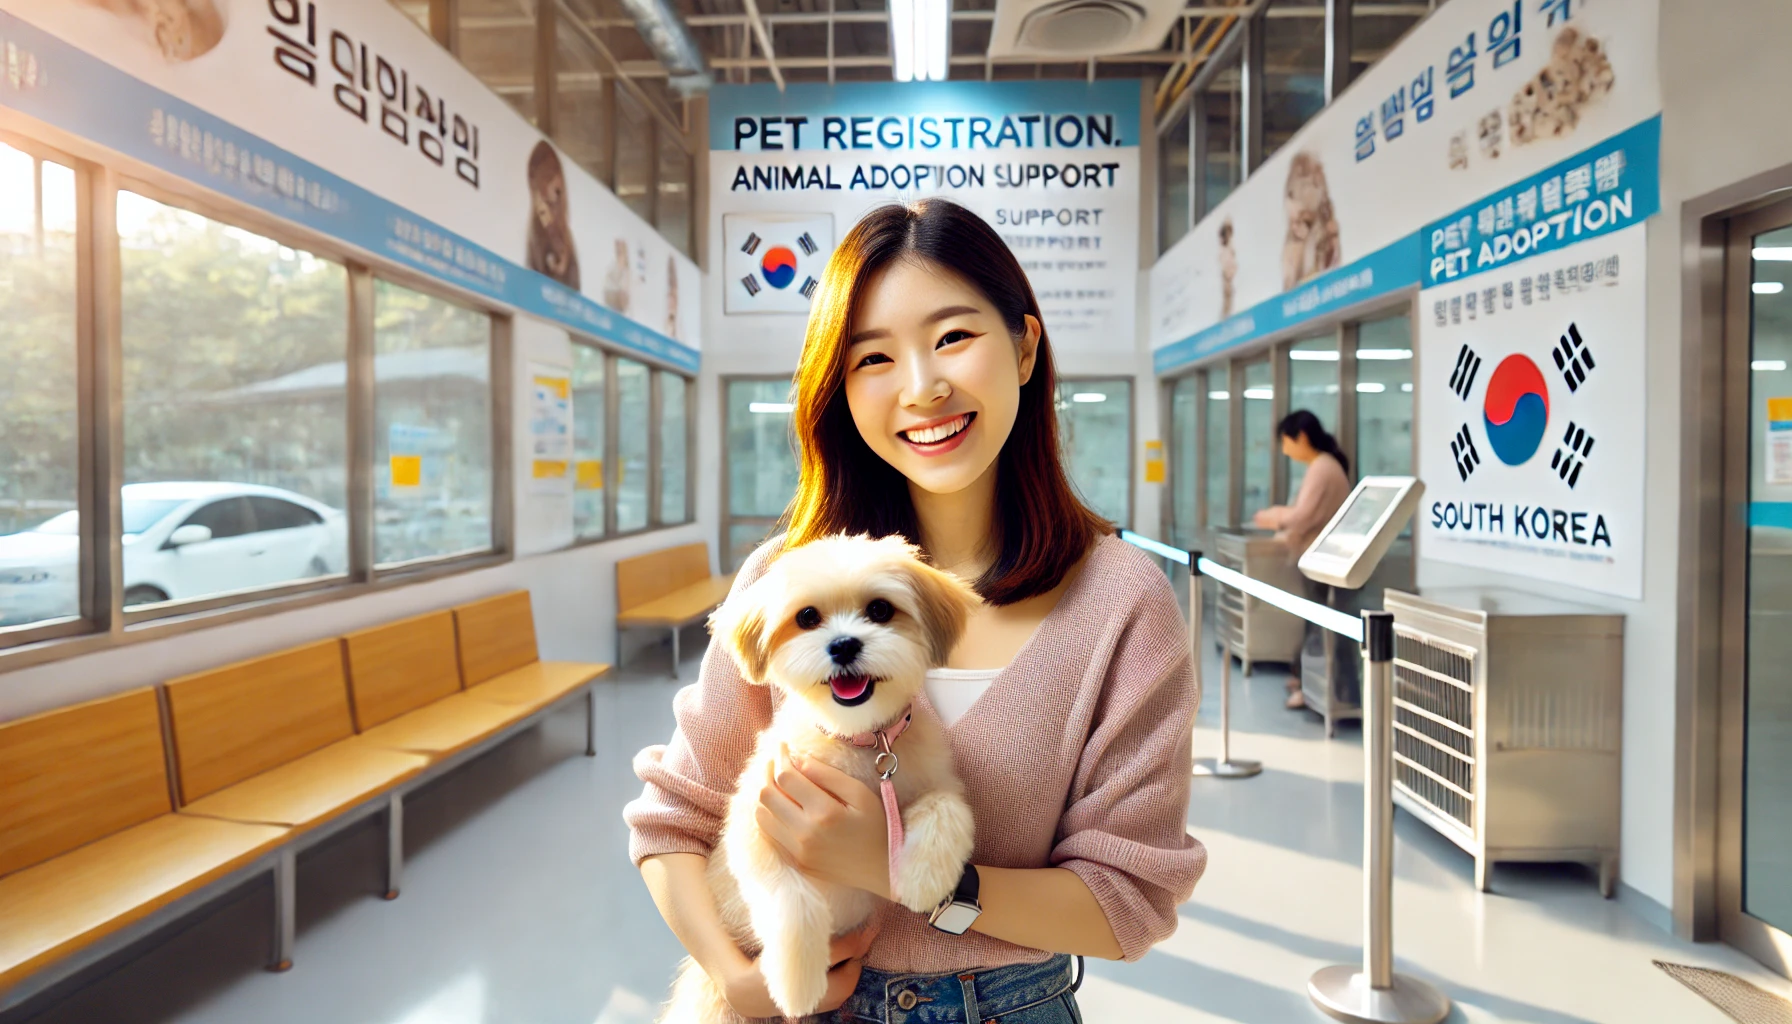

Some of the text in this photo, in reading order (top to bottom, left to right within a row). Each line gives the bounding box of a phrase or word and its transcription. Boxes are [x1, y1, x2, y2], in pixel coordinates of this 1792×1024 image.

[734, 113, 1122, 151] PET REGISTRATION.
[731, 162, 1120, 192] ANIMAL ADOPTION SUPPORT
[996, 208, 1104, 226] SUPPORT
[1430, 247, 1473, 282] PET
[1477, 187, 1633, 268] ADOPTION
[1431, 501, 1612, 548] SOUTH KOREA
